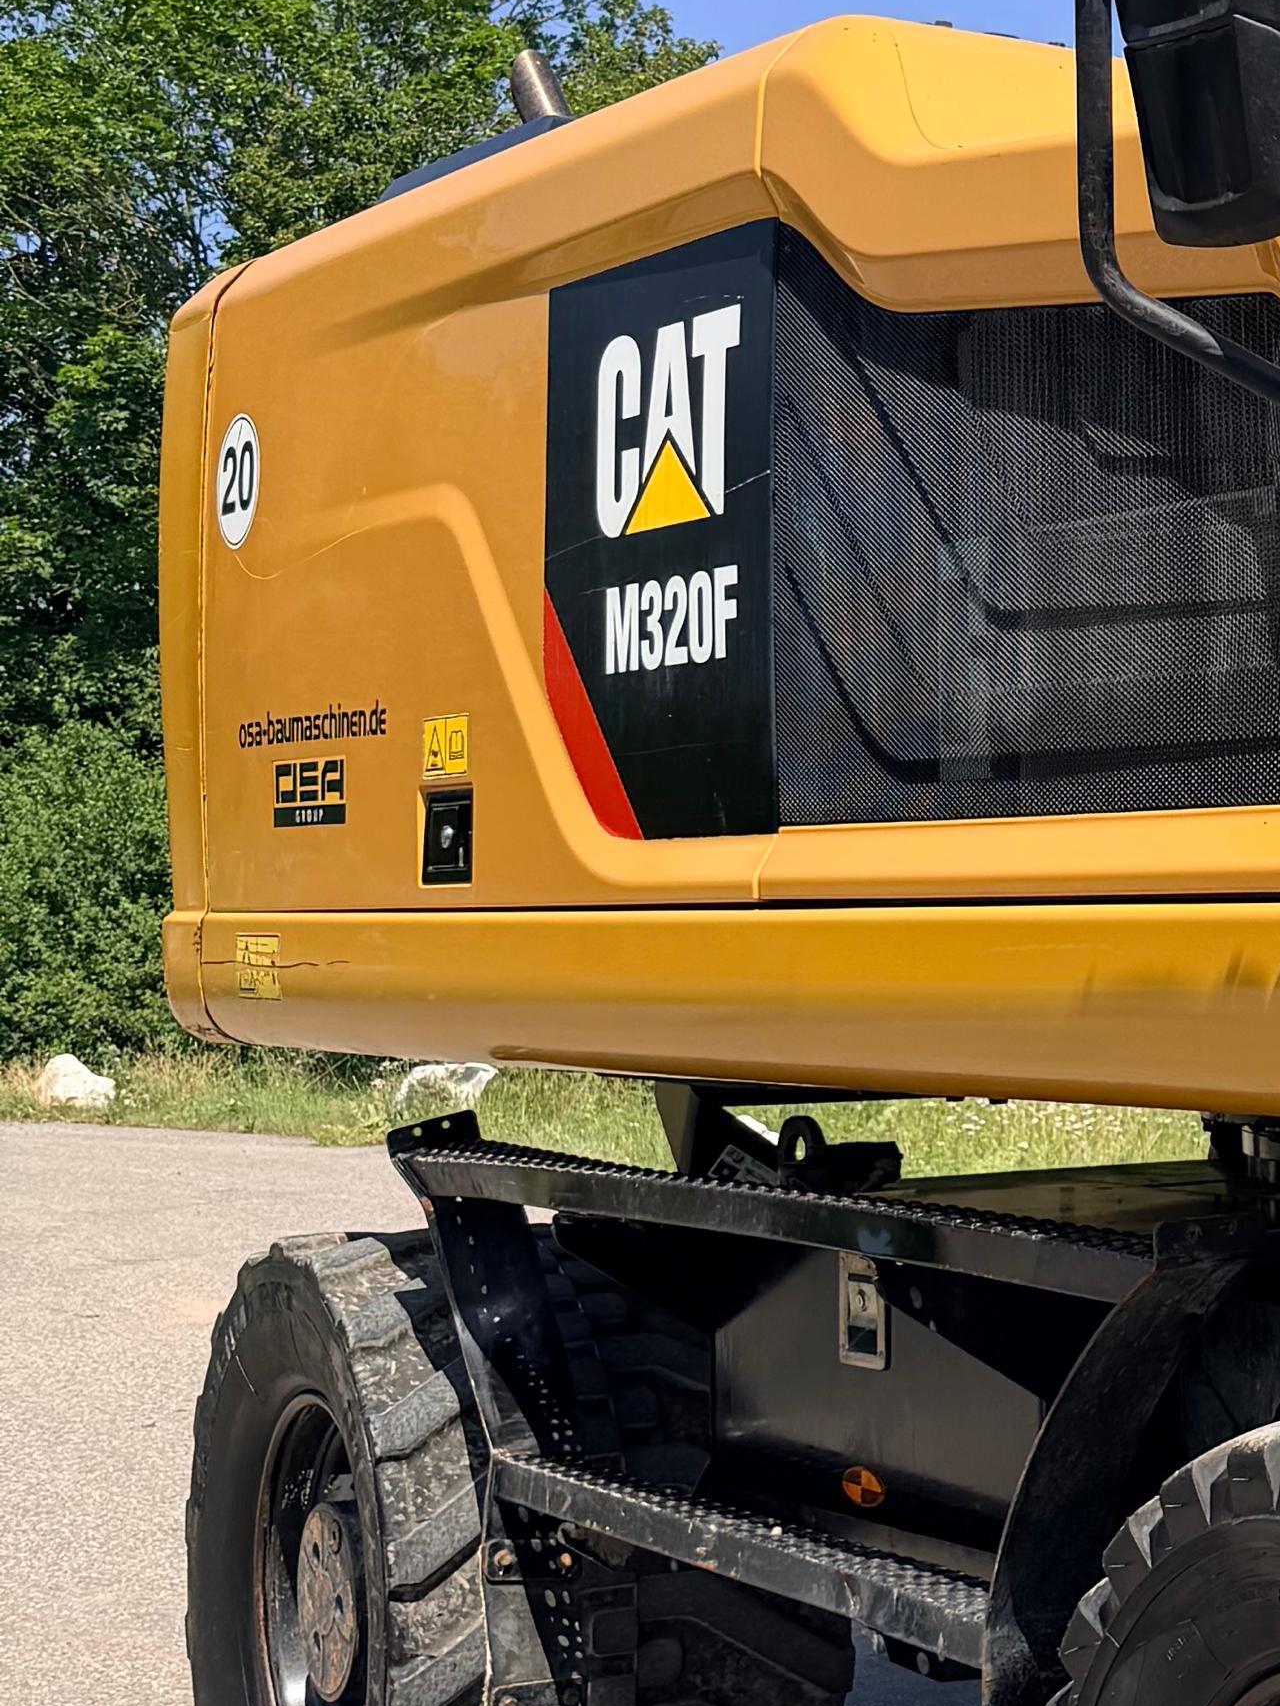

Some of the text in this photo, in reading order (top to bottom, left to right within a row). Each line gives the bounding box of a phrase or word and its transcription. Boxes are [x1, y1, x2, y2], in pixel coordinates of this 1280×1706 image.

[596, 304, 741, 539] CAT
[221, 441, 254, 515] 20
[605, 565, 739, 676] M320F
[239, 699, 387, 748] osa-baumaschinen.de
[295, 809, 324, 823] GROUP
